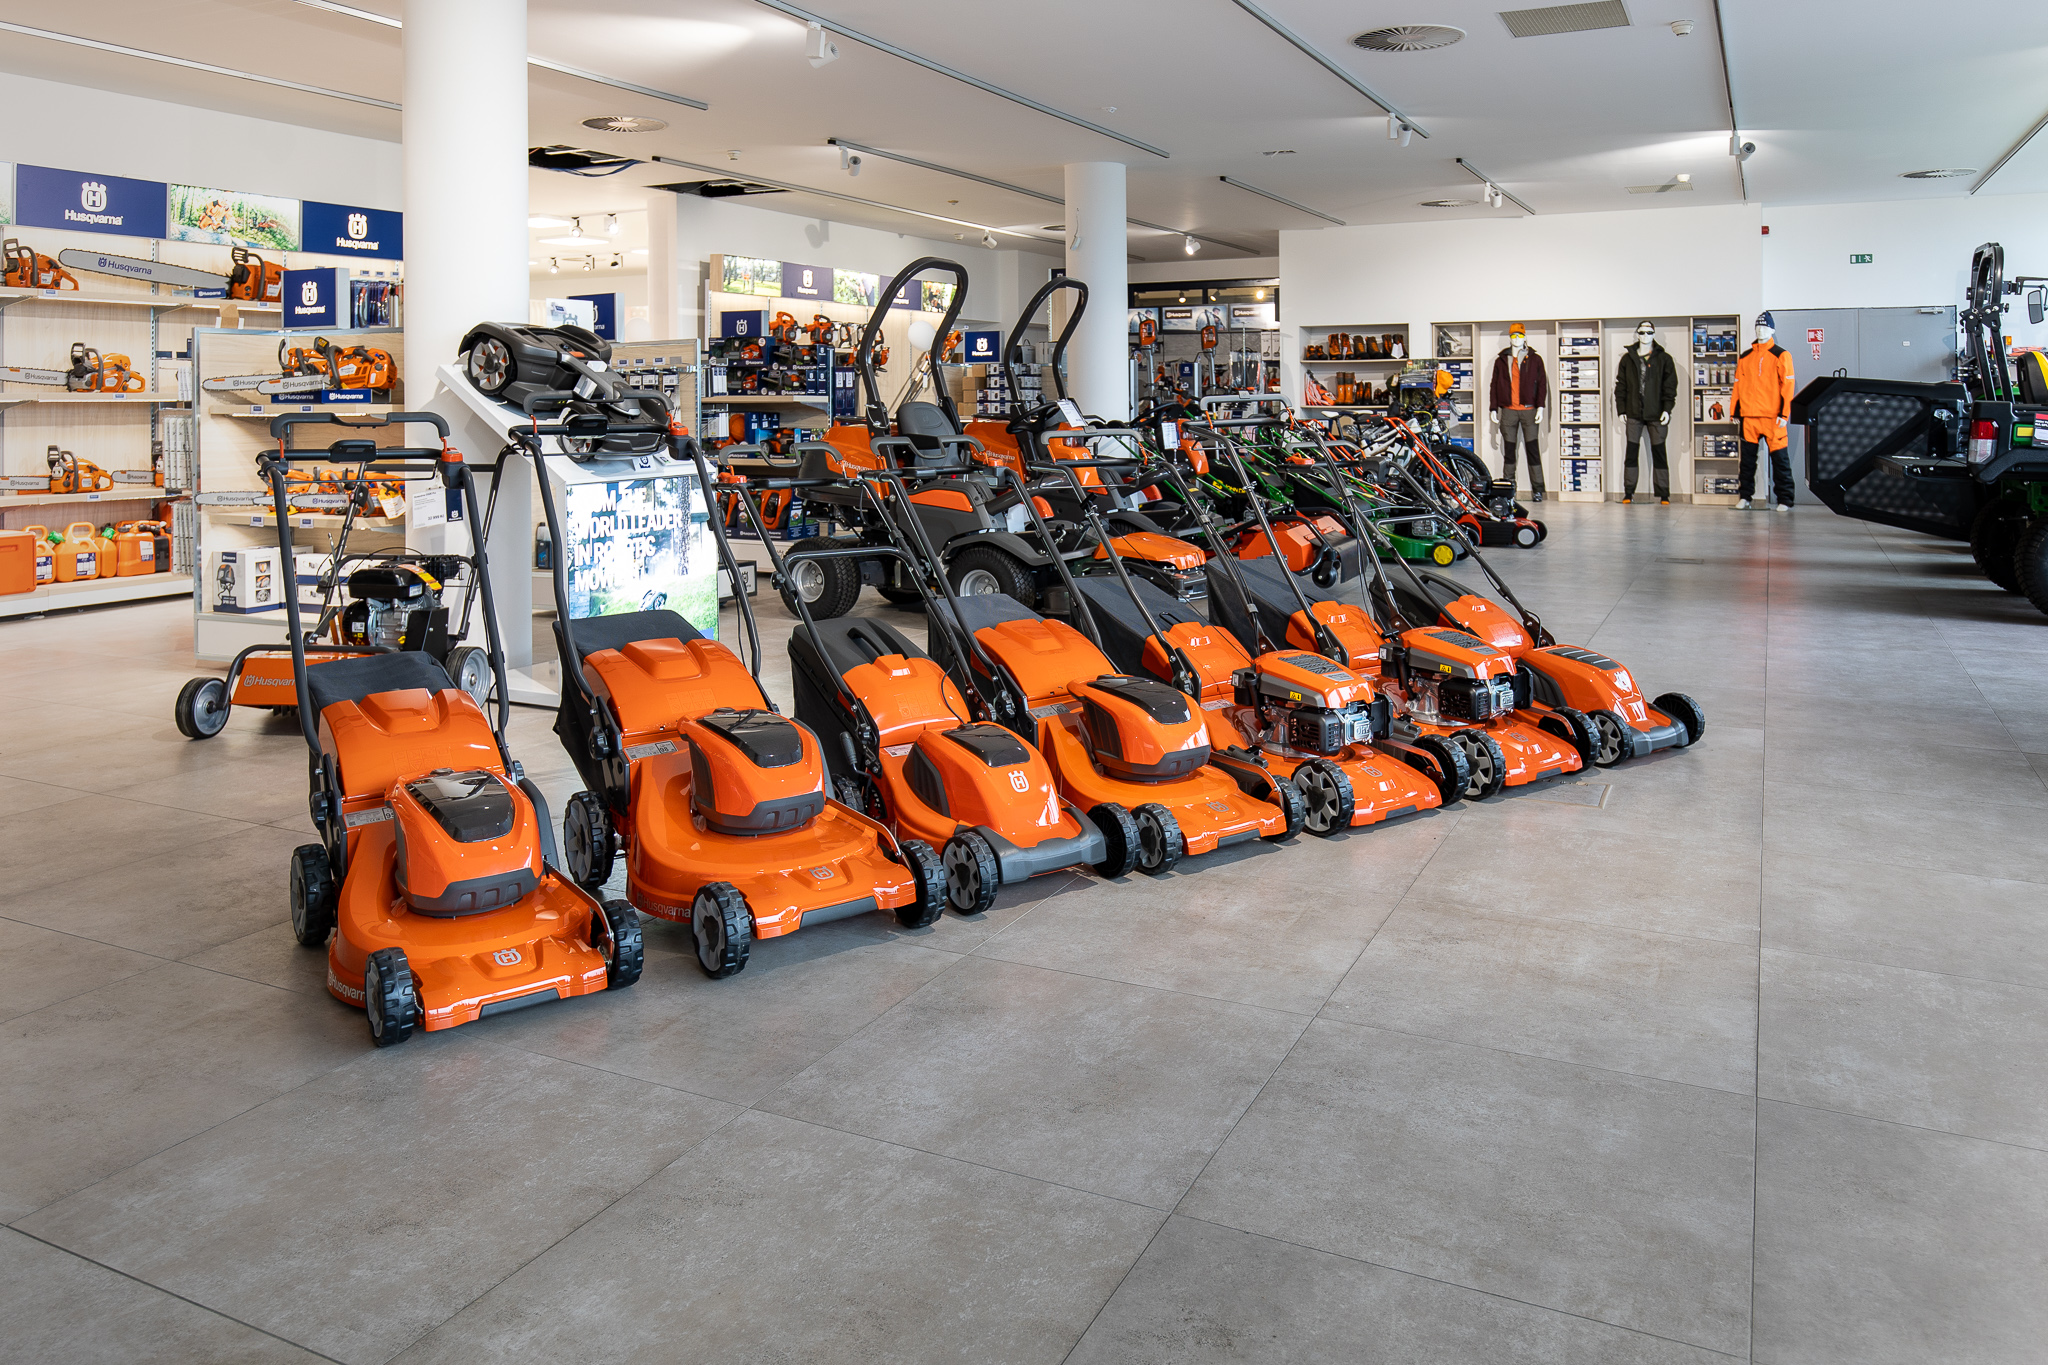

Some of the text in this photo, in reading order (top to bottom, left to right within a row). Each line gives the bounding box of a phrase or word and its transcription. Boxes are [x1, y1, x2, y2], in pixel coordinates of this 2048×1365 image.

[65, 209, 123, 225] Husqvarna
[336, 237, 379, 250] Husqvarna
[107, 260, 152, 275] Husqvarna
[295, 305, 325, 315] Husqvarna
[30, 373, 58, 381] Husqvarna
[290, 379, 323, 388] Husqvarna
[629, 509, 682, 532] LEADER
[574, 543, 591, 566] IN
[254, 676, 296, 687] Husqvarn
[643, 896, 691, 918] Husqvarna
[331, 975, 365, 1001] Husqvarn
